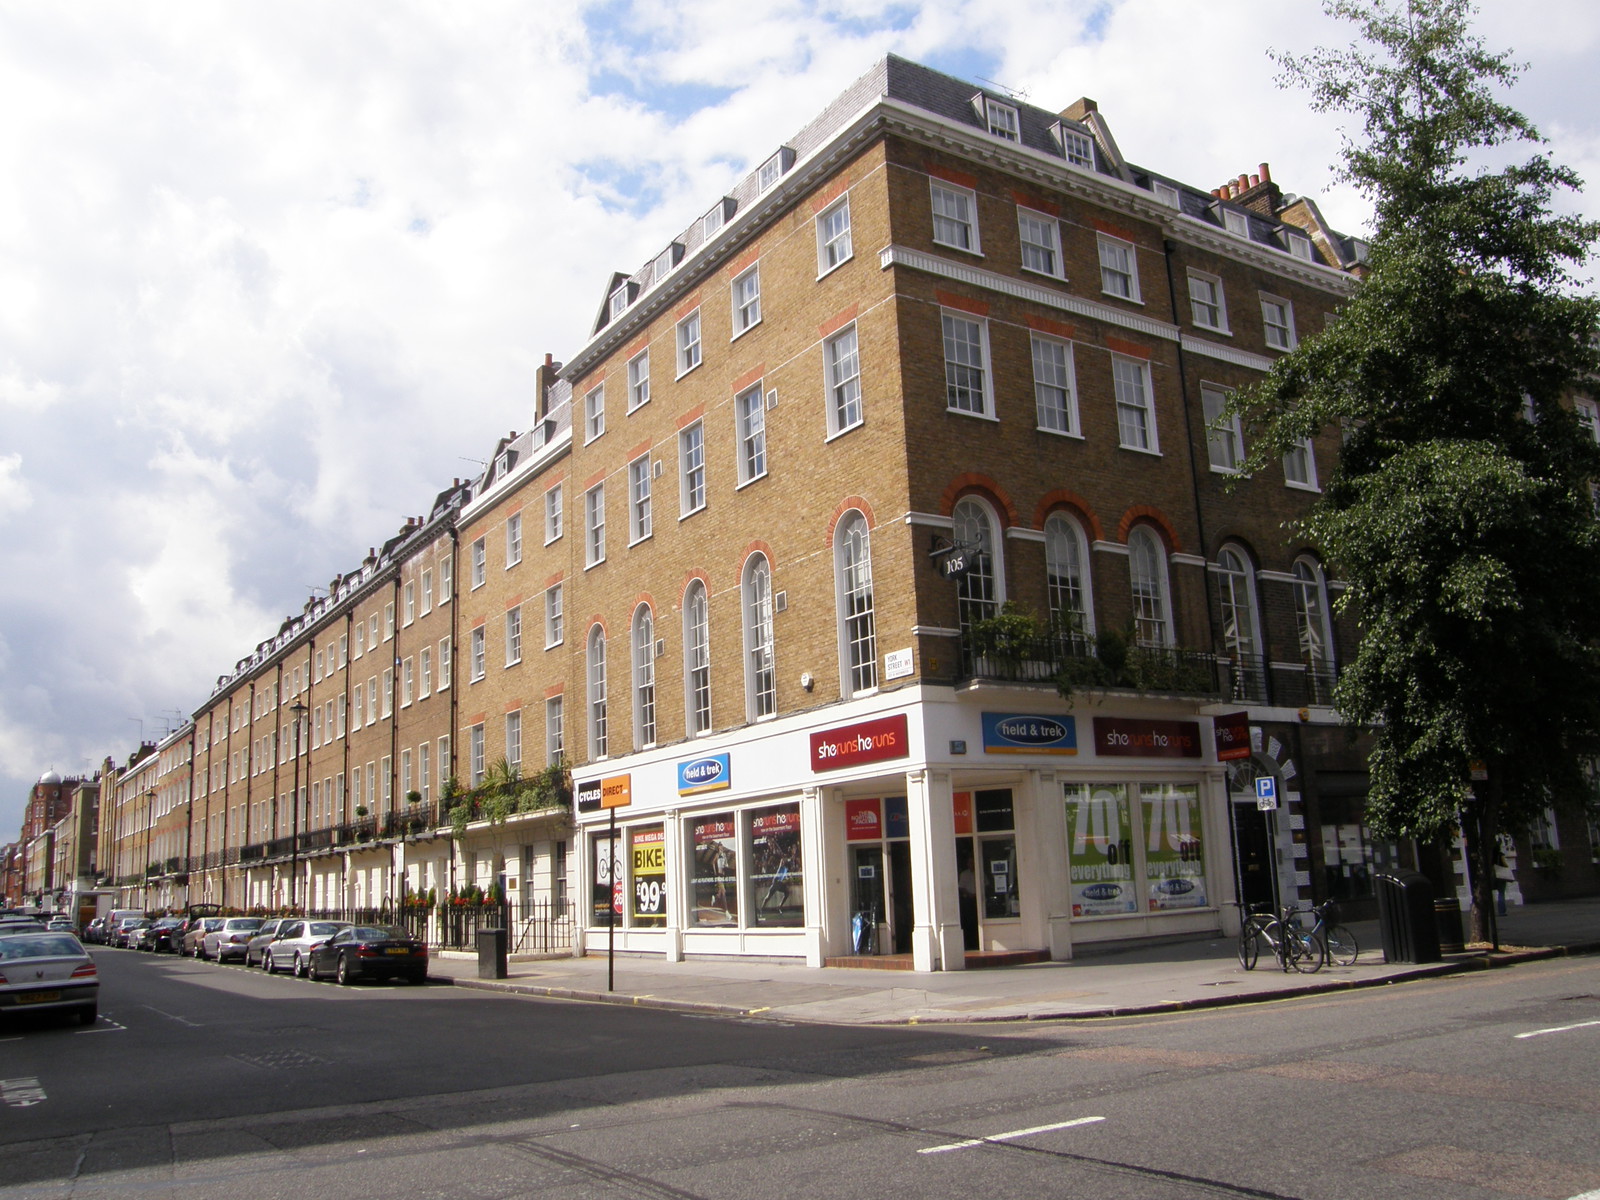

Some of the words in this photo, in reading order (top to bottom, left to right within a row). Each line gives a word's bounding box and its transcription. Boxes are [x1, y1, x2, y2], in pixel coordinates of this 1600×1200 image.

[947, 556, 964, 574] 105
[887, 654, 898, 663] YORK
[887, 660, 903, 671] STREET
[1002, 723, 1027, 736] field
[1030, 724, 1038, 736] &
[1041, 725, 1063, 737] trek
[686, 766, 700, 780] field
[700, 765, 706, 776] &
[706, 762, 720, 776] trek
[579, 788, 601, 803] CYCLES
[603, 784, 623, 797] DIRECT
[1260, 779, 1271, 796] P
[634, 834, 644, 843] BIKE
[1071, 862, 1131, 881] everything
